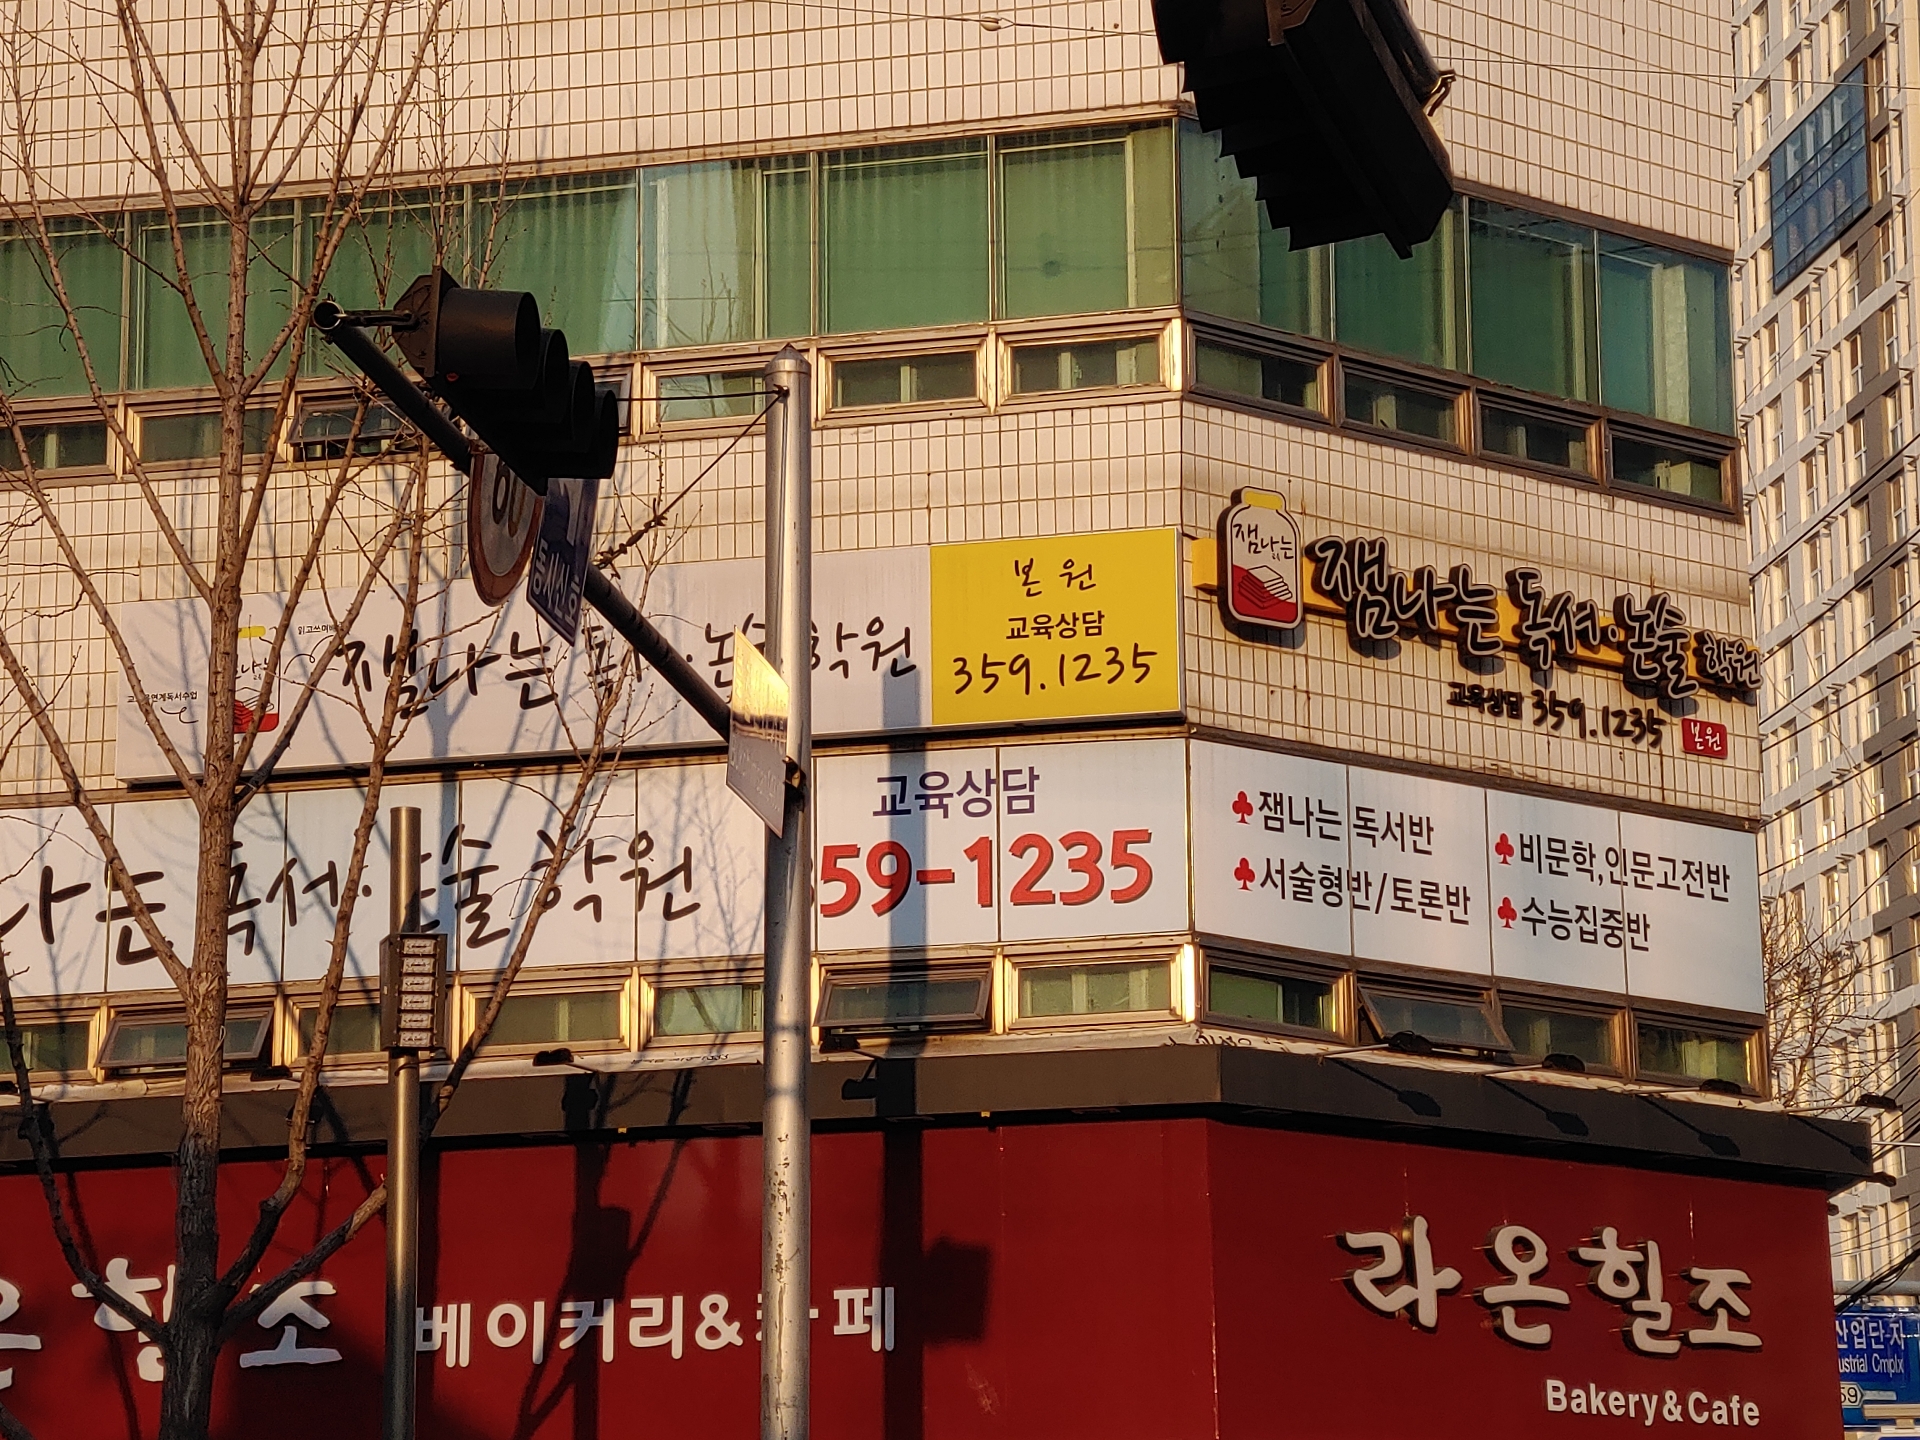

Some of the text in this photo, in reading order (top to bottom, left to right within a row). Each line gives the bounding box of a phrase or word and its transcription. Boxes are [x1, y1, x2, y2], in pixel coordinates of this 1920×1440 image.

[1233, 523, 1294, 560] 잼나는
[1006, 610, 1106, 642] 교육상담
[1310, 536, 1504, 656] 잼나는
[1700, 630, 1764, 690] 학원
[335, 629, 558, 719] 잼나는
[952, 642, 1159, 695] 359.1235
[1447, 681, 1667, 749] 교육상담 359.1235
[1690, 721, 1723, 752] 본원
[872, 766, 1041, 818] 교육상담
[1258, 789, 1436, 857] 잼나는 독서반
[810, 828, 1153, 916] 59-1235
[1260, 857, 1472, 927] 서술형반/토론반
[1519, 832, 1731, 903] 비문학,인문고전반
[1520, 896, 1652, 954] 수능집중반
[1344, 1214, 1764, 1354] 라온힐조
[415, 1286, 896, 1370] 베이커리&페
[1872, 1353, 1905, 1378] Cmplx
[1546, 1379, 1761, 1427] Bakery&Cafe
